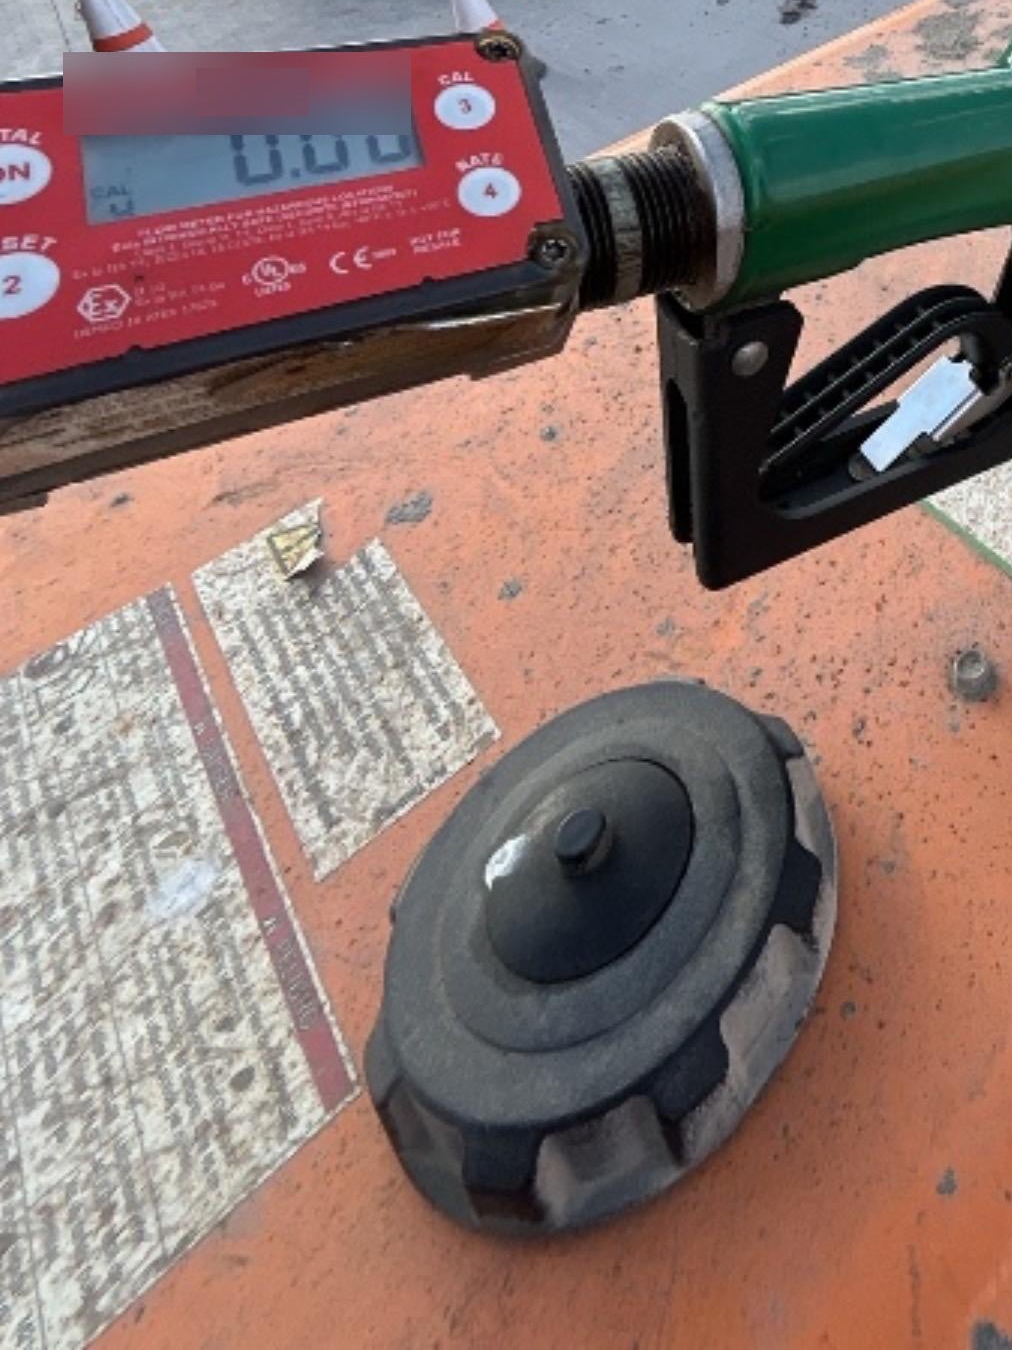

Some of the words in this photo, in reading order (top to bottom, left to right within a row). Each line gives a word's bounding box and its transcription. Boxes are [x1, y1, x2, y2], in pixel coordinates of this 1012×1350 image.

[437, 71, 475, 85] CAL
[458, 98, 472, 115] 3
[482, 183, 498, 199] 4
[2, 275, 22, 296] 2
